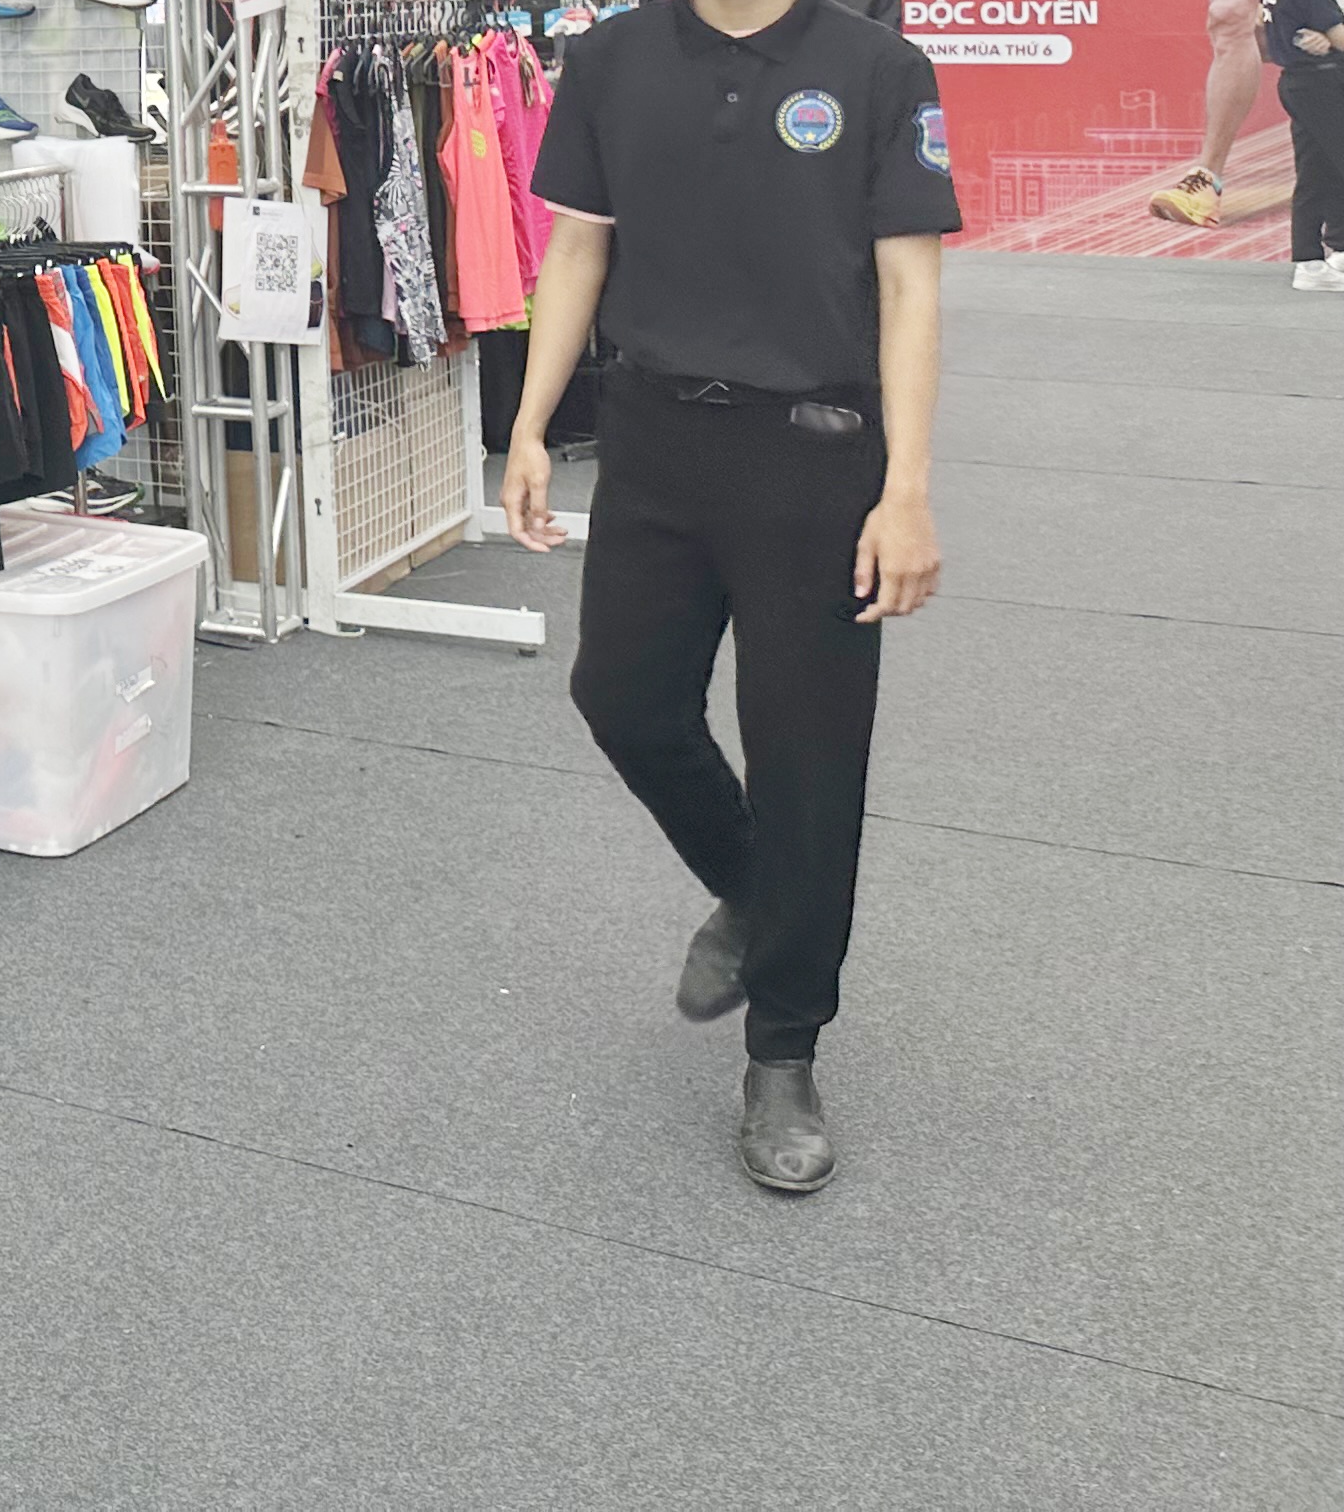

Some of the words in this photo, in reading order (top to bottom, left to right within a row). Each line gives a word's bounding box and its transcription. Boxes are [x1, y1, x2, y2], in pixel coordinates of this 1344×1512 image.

[963, 40, 1001, 56] MÙA
[1004, 40, 1038, 56] THỨ
[1042, 44, 1053, 56] 6
